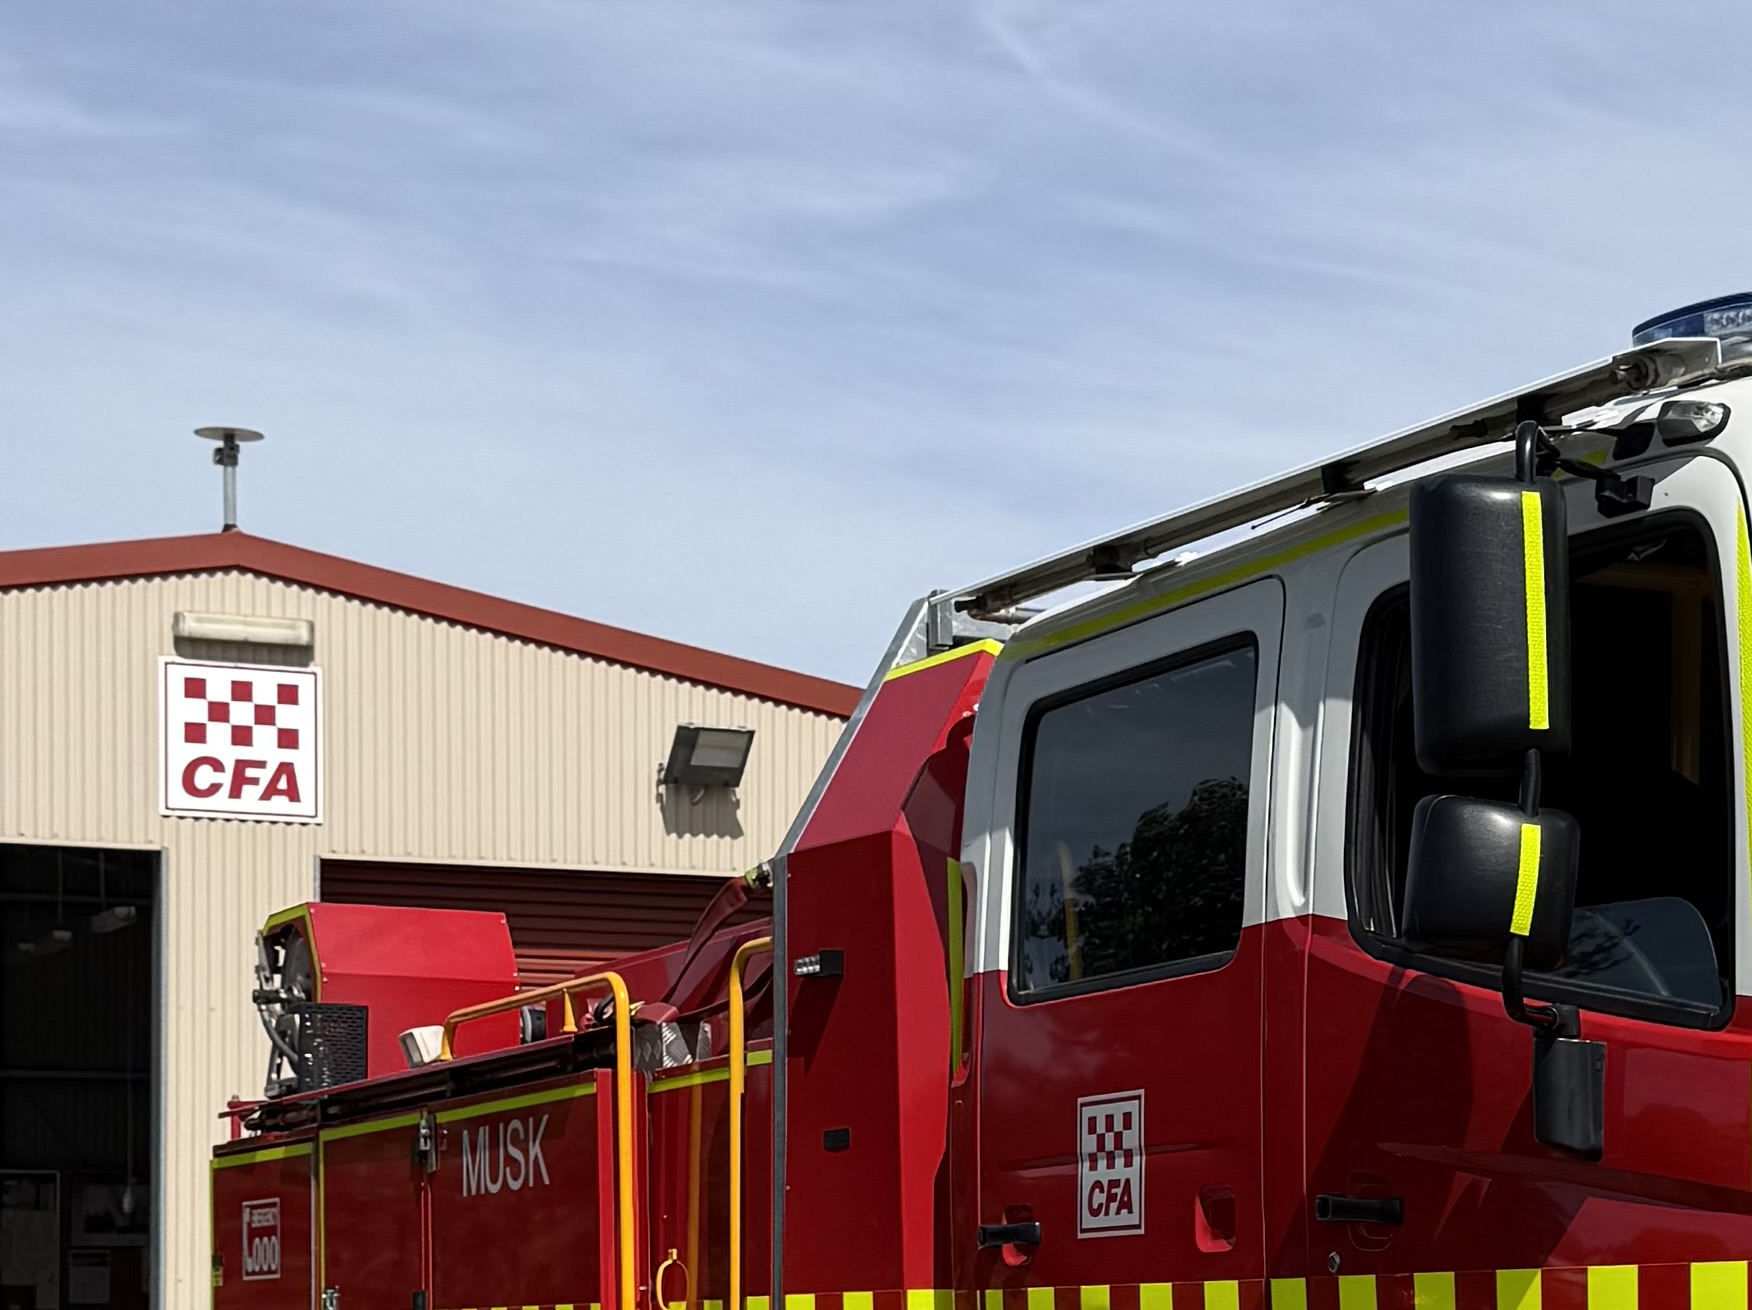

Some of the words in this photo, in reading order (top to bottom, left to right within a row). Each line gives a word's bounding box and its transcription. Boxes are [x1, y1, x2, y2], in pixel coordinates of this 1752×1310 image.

[181, 755, 302, 803] CFA
[462, 1113, 550, 1198] MUSK
[1087, 1177, 1134, 1218] CFA
